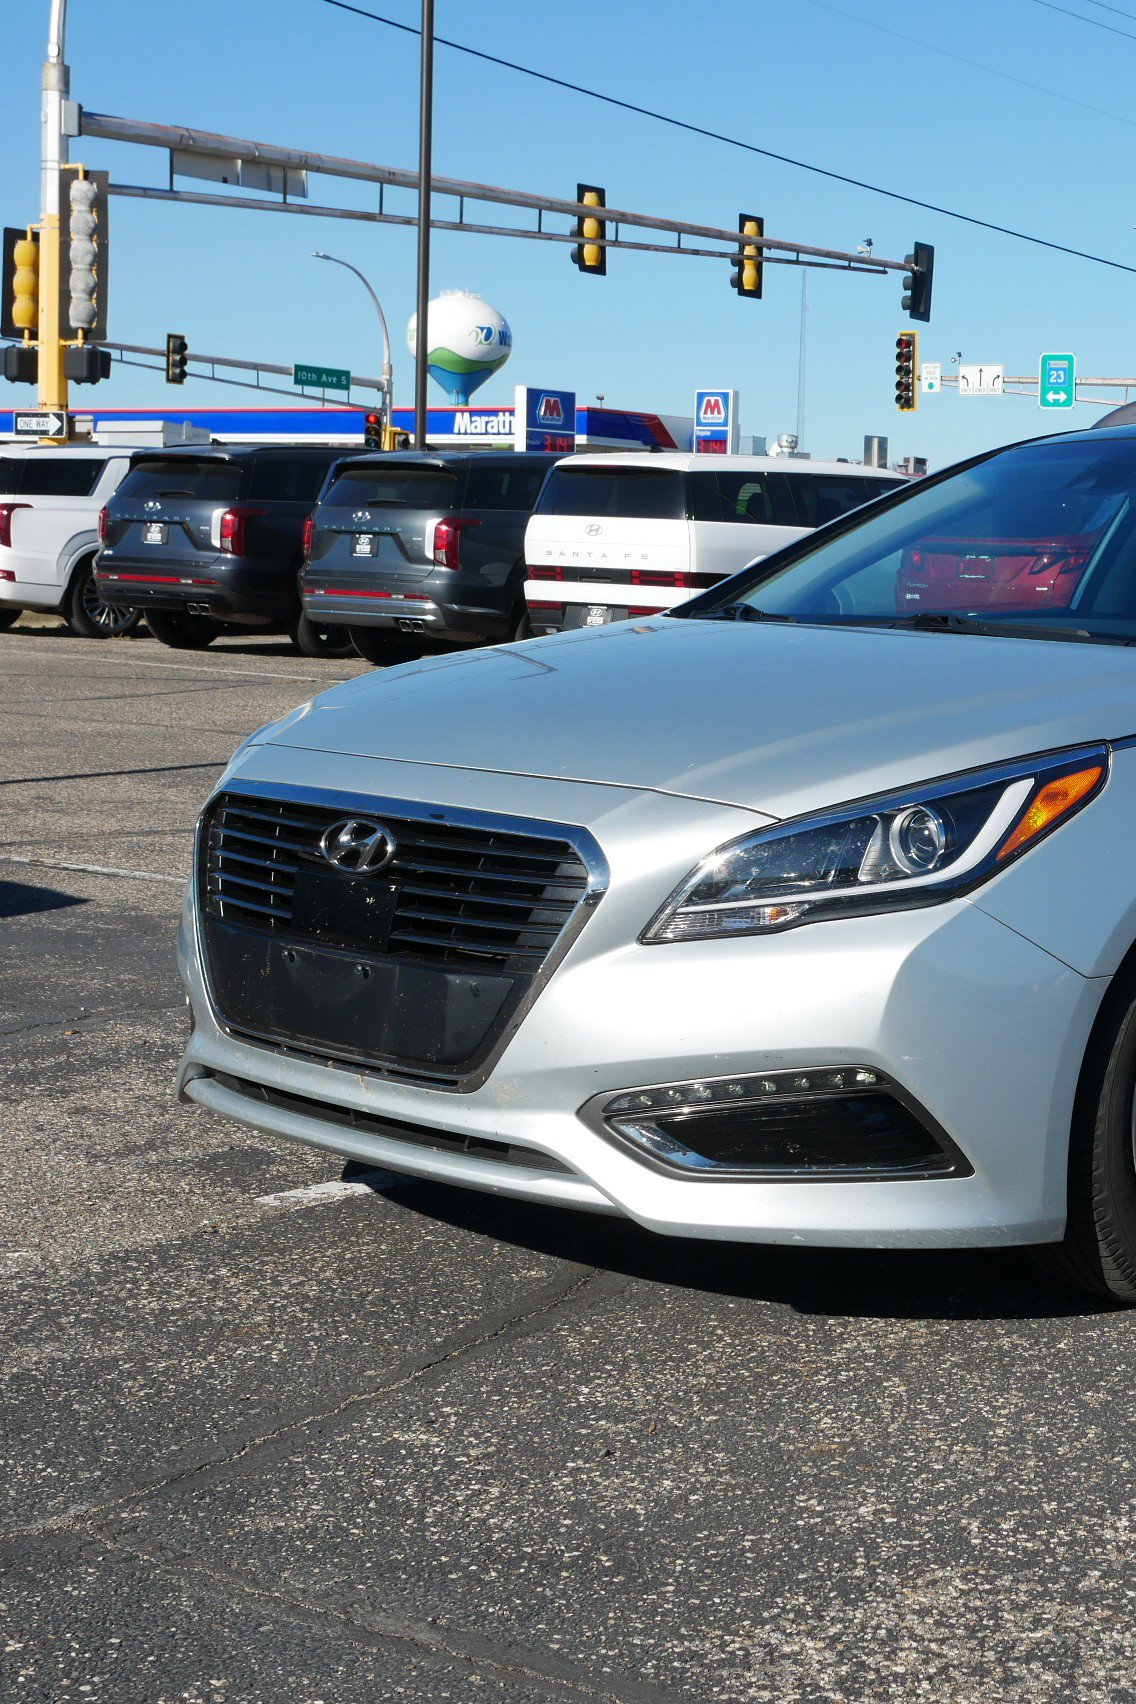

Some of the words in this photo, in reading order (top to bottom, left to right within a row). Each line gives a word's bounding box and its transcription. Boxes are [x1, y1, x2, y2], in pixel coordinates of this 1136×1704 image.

[298, 370, 317, 382] 10th
[321, 373, 338, 384] Ave
[341, 375, 347, 385] S
[1049, 370, 1065, 383] 23
[703, 398, 722, 416] M
[19, 419, 33, 429] ONE
[35, 419, 50, 428] WAY
[546, 549, 609, 559] SANTA
